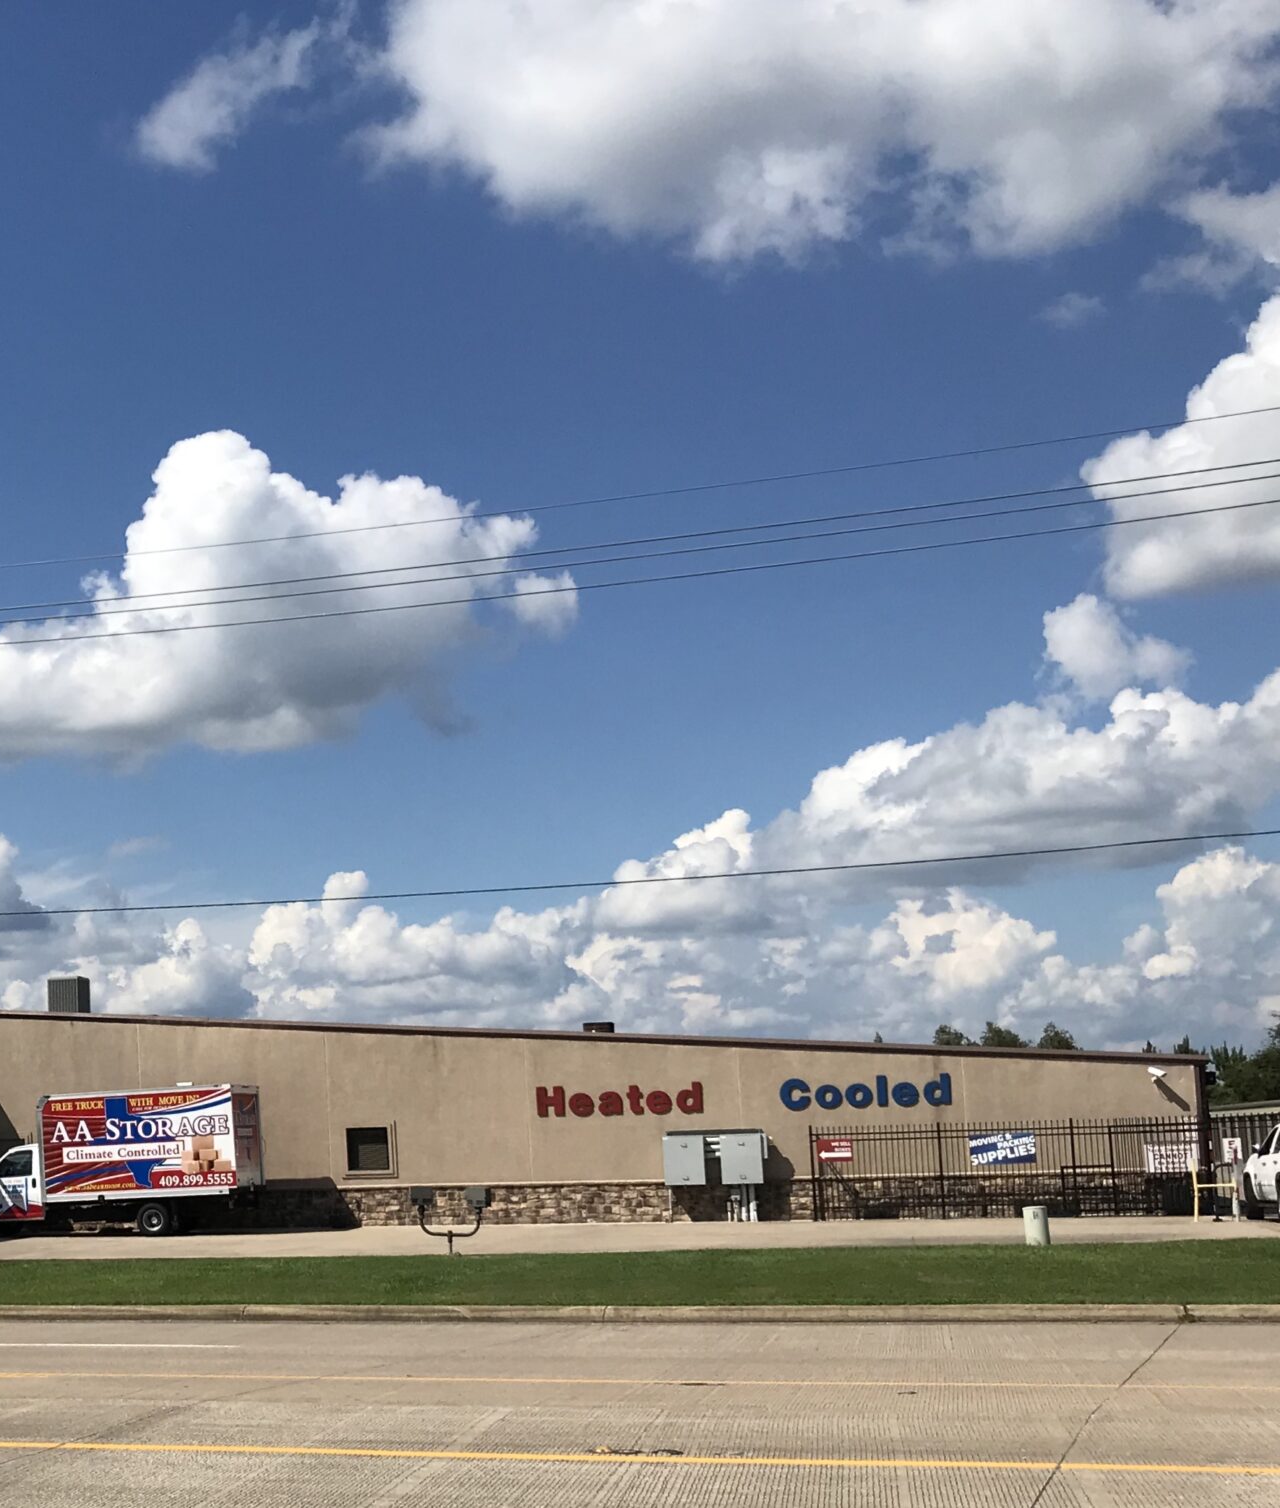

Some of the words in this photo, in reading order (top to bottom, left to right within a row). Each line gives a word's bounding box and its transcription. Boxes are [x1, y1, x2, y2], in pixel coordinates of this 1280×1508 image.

[535, 1081, 705, 1118] Heated
[779, 1073, 953, 1111] Cooled
[51, 1102, 73, 1111] FREE
[75, 1100, 104, 1110] TRUCK
[129, 1097, 153, 1106] WITH
[159, 1095, 184, 1105] MOVE
[50, 1120, 94, 1143] AA
[105, 1114, 230, 1141] STORAGE
[969, 1134, 1004, 1148] MOVING
[996, 1135, 1036, 1149] PACKING
[66, 1149, 113, 1161] Climate
[117, 1144, 180, 1158] Controlled
[970, 1143, 1036, 1166] SUPPLIES
[159, 1173, 233, 1187] 409.899.5555
